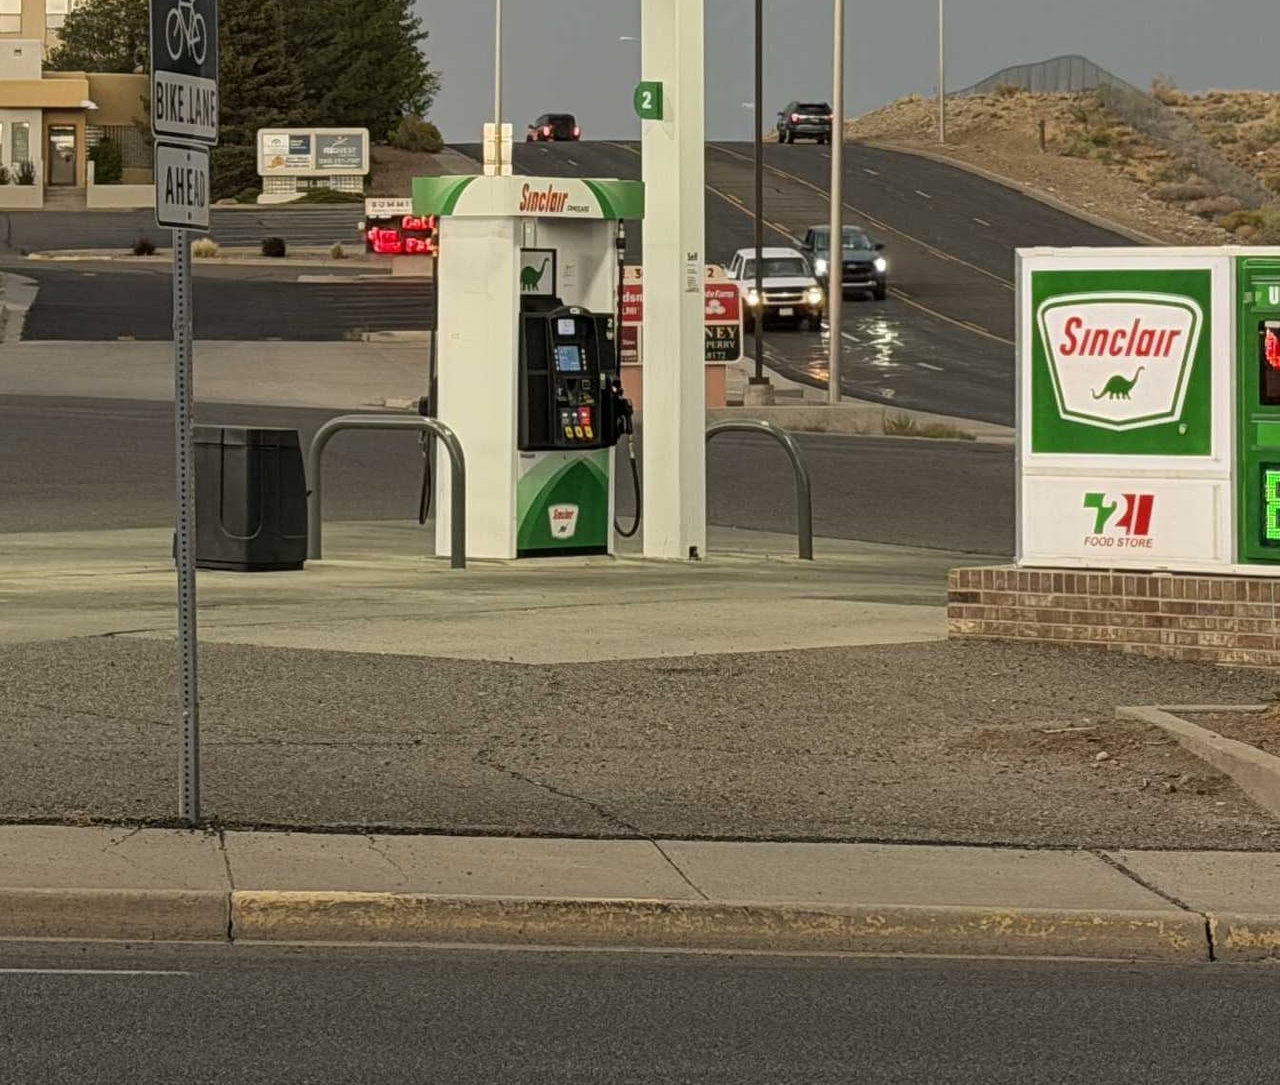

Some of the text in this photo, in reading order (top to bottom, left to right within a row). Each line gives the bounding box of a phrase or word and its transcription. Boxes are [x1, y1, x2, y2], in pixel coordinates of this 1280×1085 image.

[156, 81, 216, 128] BIKE LANE
[642, 91, 652, 109] 2
[165, 166, 206, 208] AHEAD
[520, 183, 568, 213] Sinclair
[1059, 316, 1183, 357] Sinclair
[1083, 536, 1153, 548] FOOD STORE
